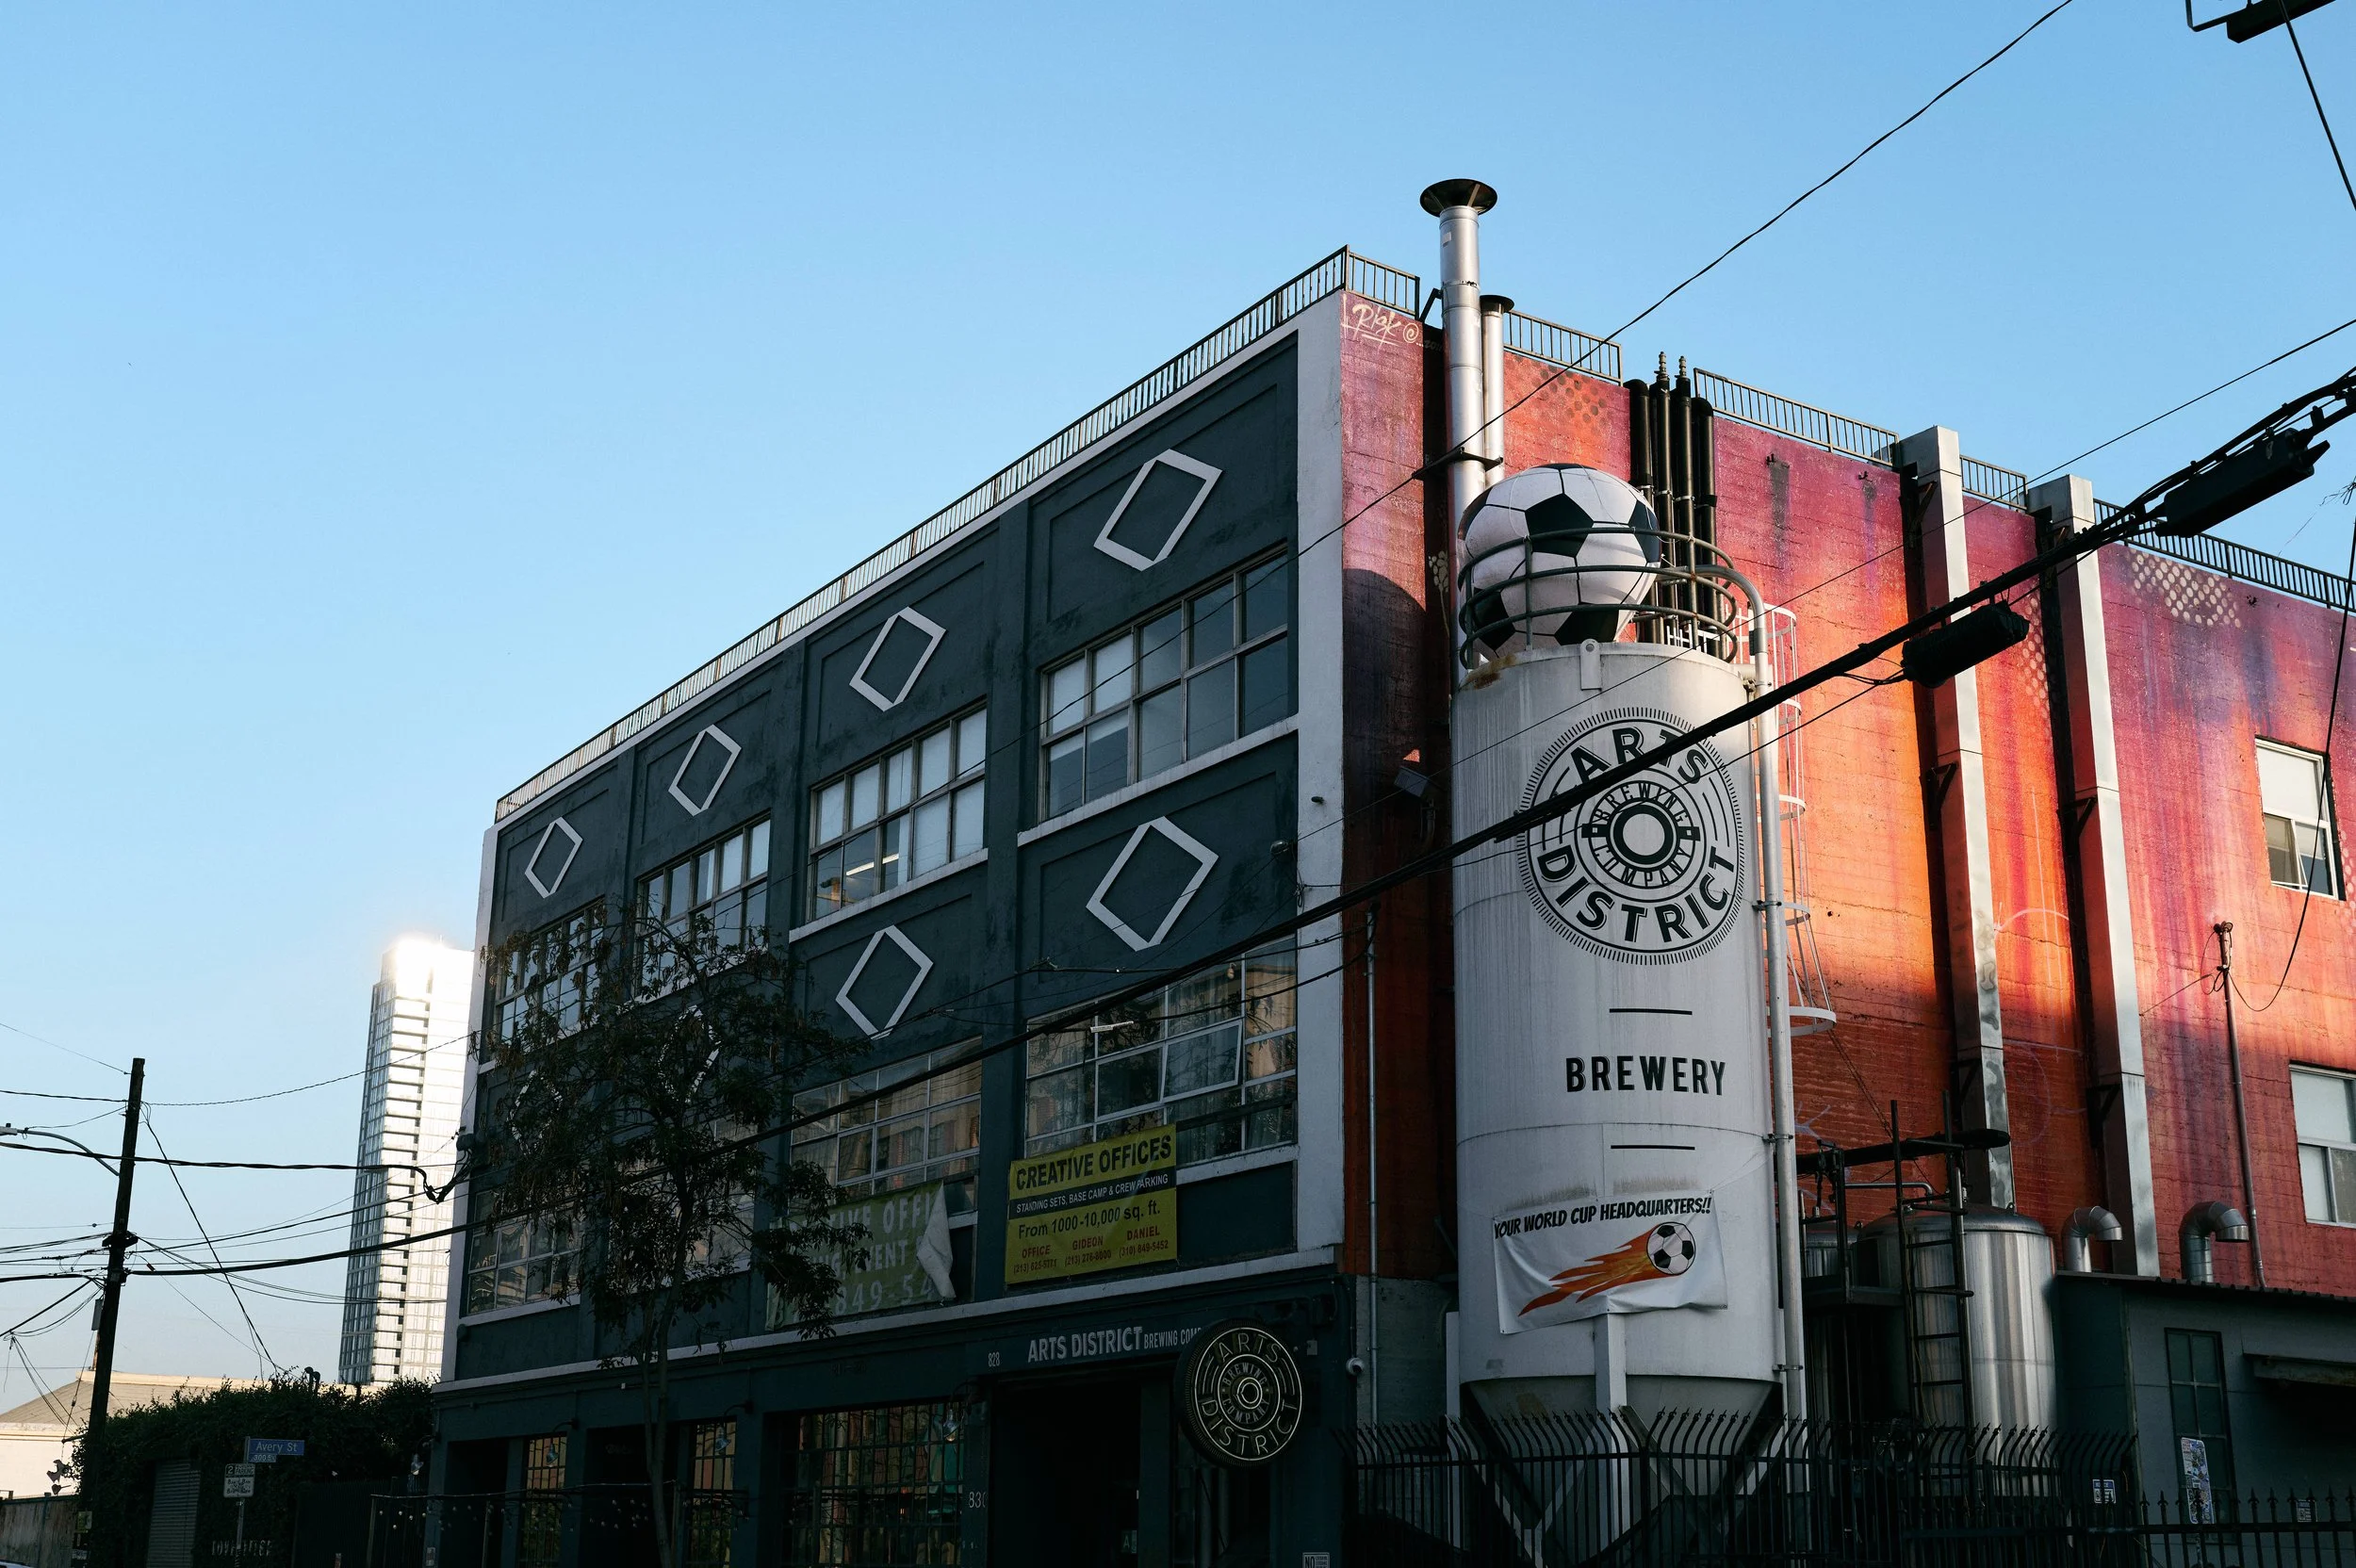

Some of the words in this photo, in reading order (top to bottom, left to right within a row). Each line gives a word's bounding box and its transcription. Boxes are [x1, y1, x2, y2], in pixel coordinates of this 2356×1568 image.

[1570, 727, 1709, 785] ARTS
[1592, 783, 1690, 823] BREWING
[1592, 844, 1692, 887] COMPANY
[1537, 844, 1735, 943] DISTRICT
[1565, 1055, 1726, 1096] BREWERY
[1016, 1152, 1094, 1191] CREATIVE
[1099, 1135, 1171, 1173] OFFICES
[1016, 1198, 1048, 1214] STANDING
[1069, 1192, 1087, 1204] BASE
[1088, 1186, 1107, 1200] CAMP
[1108, 1185, 1114, 1196] &
[1115, 1180, 1137, 1195] CREW
[1136, 1173, 1169, 1192] PARKING
[1019, 1224, 1048, 1239] From
[1123, 1206, 1144, 1222] sq.
[1148, 1200, 1160, 1216] ft.
[1494, 1217, 1521, 1239] YOUR
[1524, 1210, 1567, 1233] WORLD
[1570, 1205, 1596, 1224] CUP
[1599, 1197, 1712, 1221] HEADQUARTERS!!
[1022, 1244, 1051, 1259] OFFICE
[1072, 1235, 1104, 1250] GIDEON
[1126, 1226, 1160, 1241] DANIEL
[1064, 1255, 1080, 1267] (213)
[1119, 1245, 1136, 1258] (310)
[988, 1351, 1001, 1367] 828
[1027, 1336, 1067, 1364] ARTS
[1072, 1326, 1143, 1359] DISTRICT
[1143, 1331, 1178, 1349] BREWING
[1180, 1327, 1202, 1346] COM
[1215, 1332, 1283, 1364] ARTS
[1222, 1361, 1268, 1387] BREWING
[1201, 1397, 1298, 1455] DISTRICT
[1222, 1398, 1269, 1424] COMPANY
[256, 1442, 283, 1453] Avery
[286, 1442, 298, 1452] St
